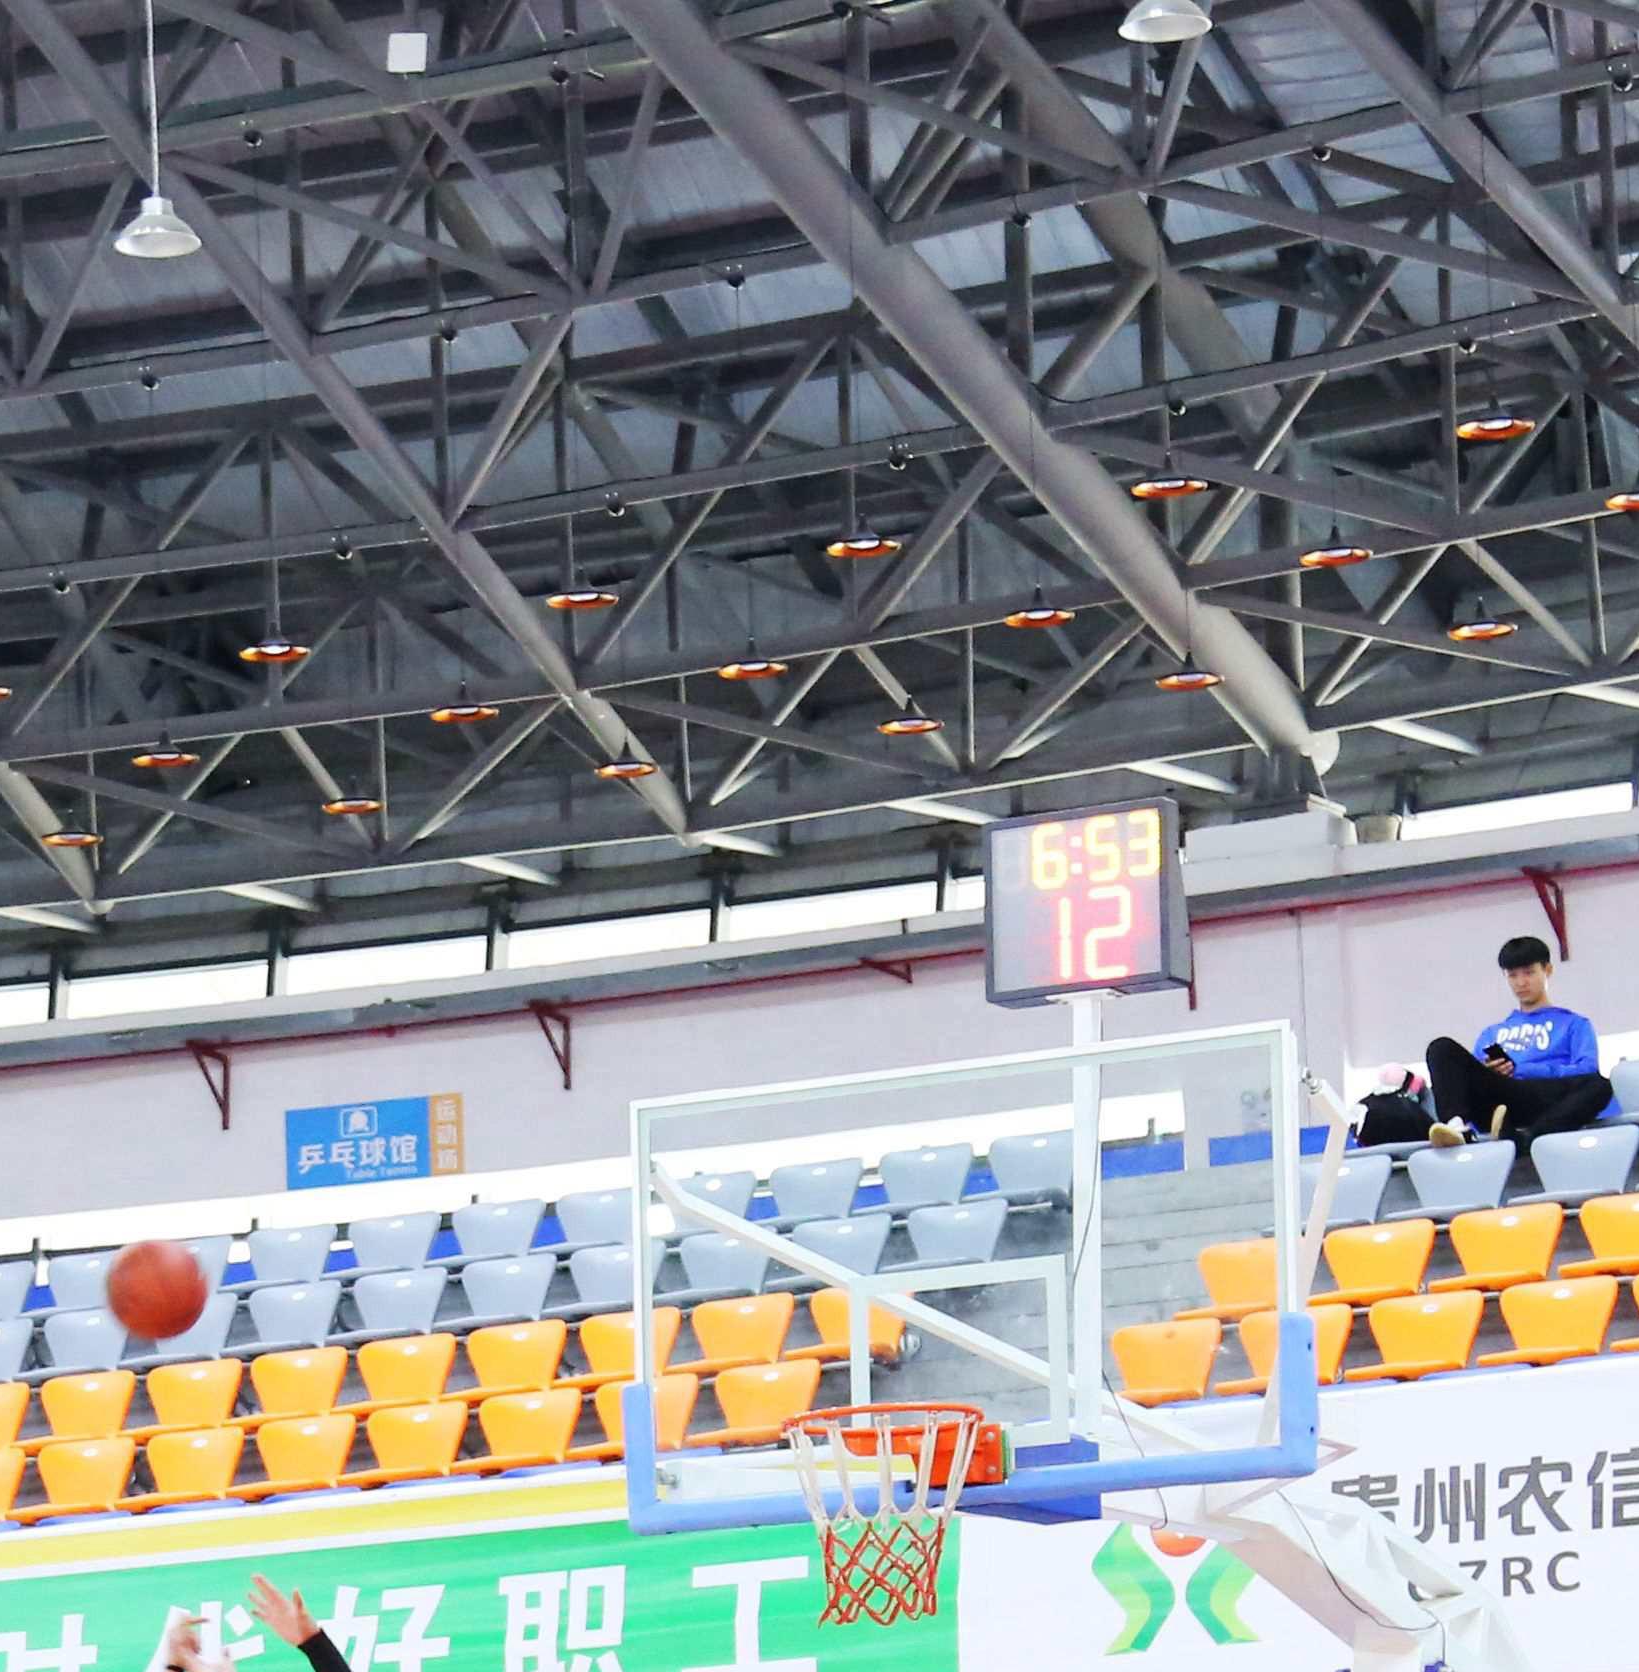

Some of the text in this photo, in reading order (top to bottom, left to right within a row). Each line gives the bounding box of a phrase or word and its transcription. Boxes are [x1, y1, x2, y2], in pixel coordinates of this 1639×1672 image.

[1030, 806, 1162, 890] 6:53
[1058, 884, 1132, 980] 12
[297, 1134, 418, 1175] 乒乓球馆
